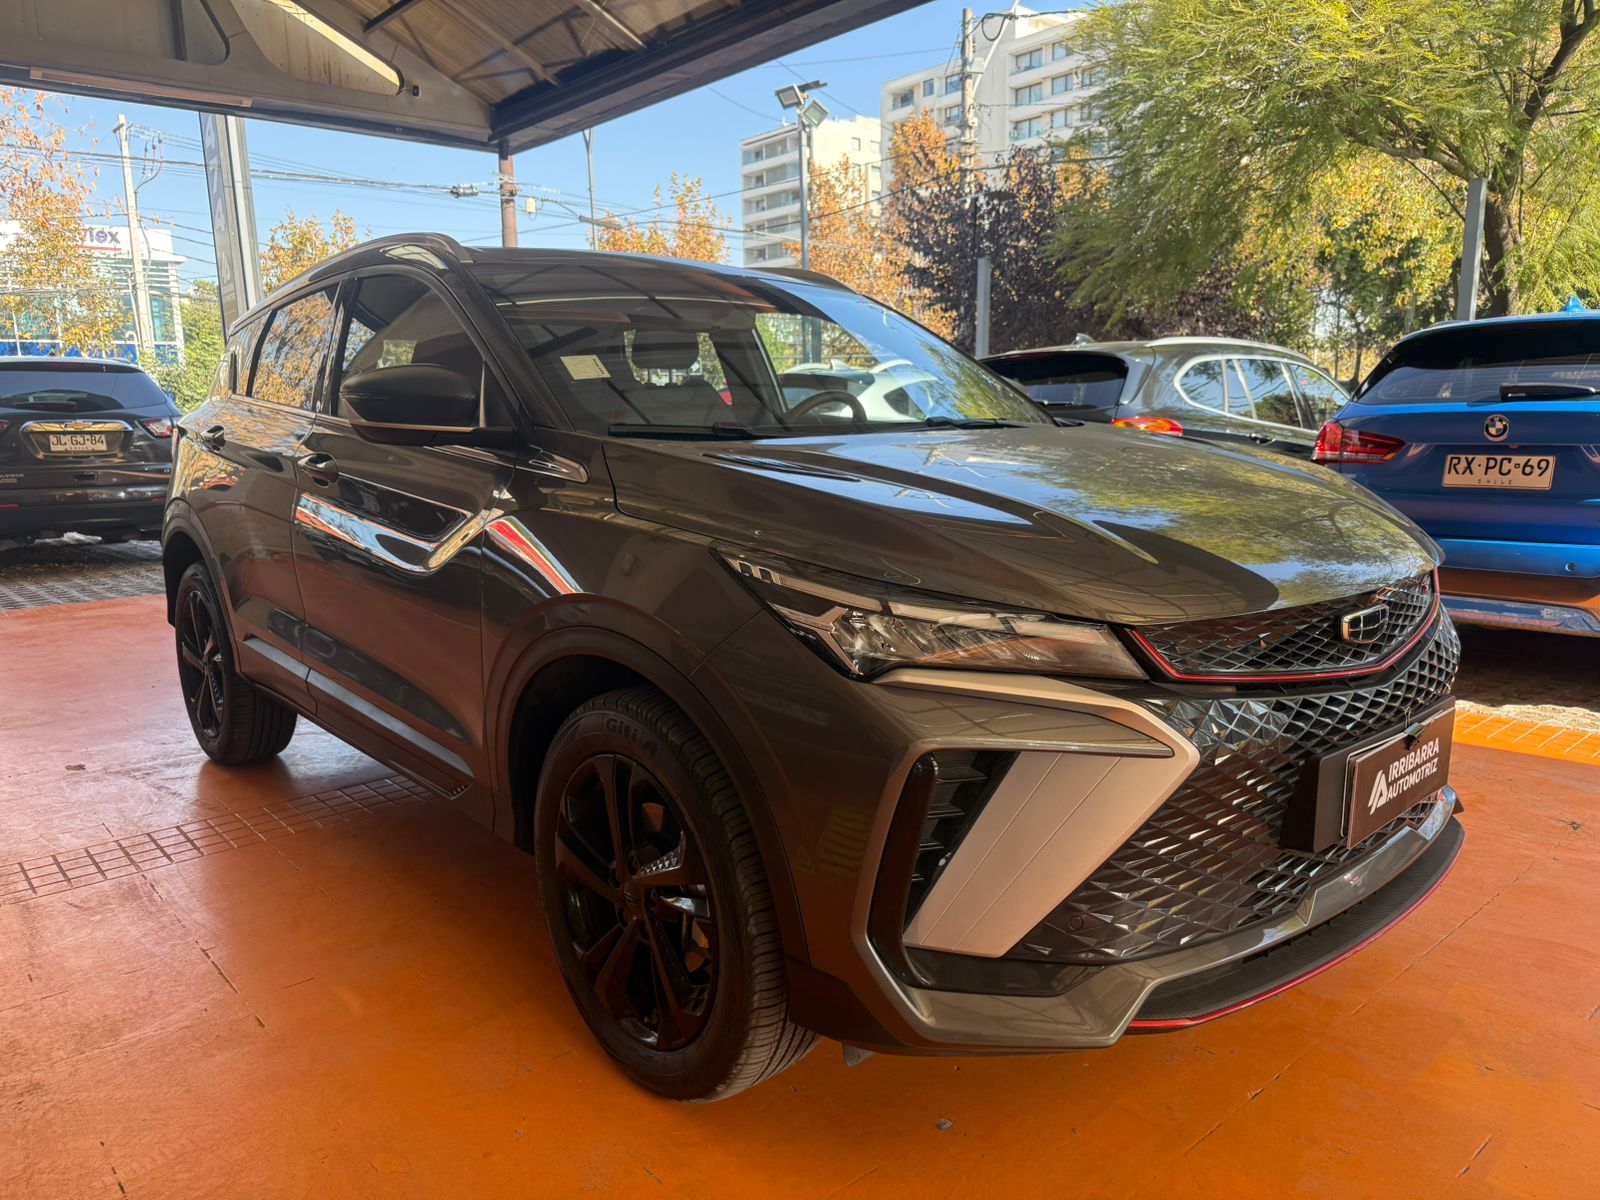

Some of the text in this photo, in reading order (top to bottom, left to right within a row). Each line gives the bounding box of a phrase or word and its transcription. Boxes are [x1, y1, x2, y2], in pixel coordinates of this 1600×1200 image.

[606, 718, 639, 742] Giti
[1386, 757, 1438, 801] AUTOMOTRIZ
[1388, 737, 1440, 782] IRRIBARRA
